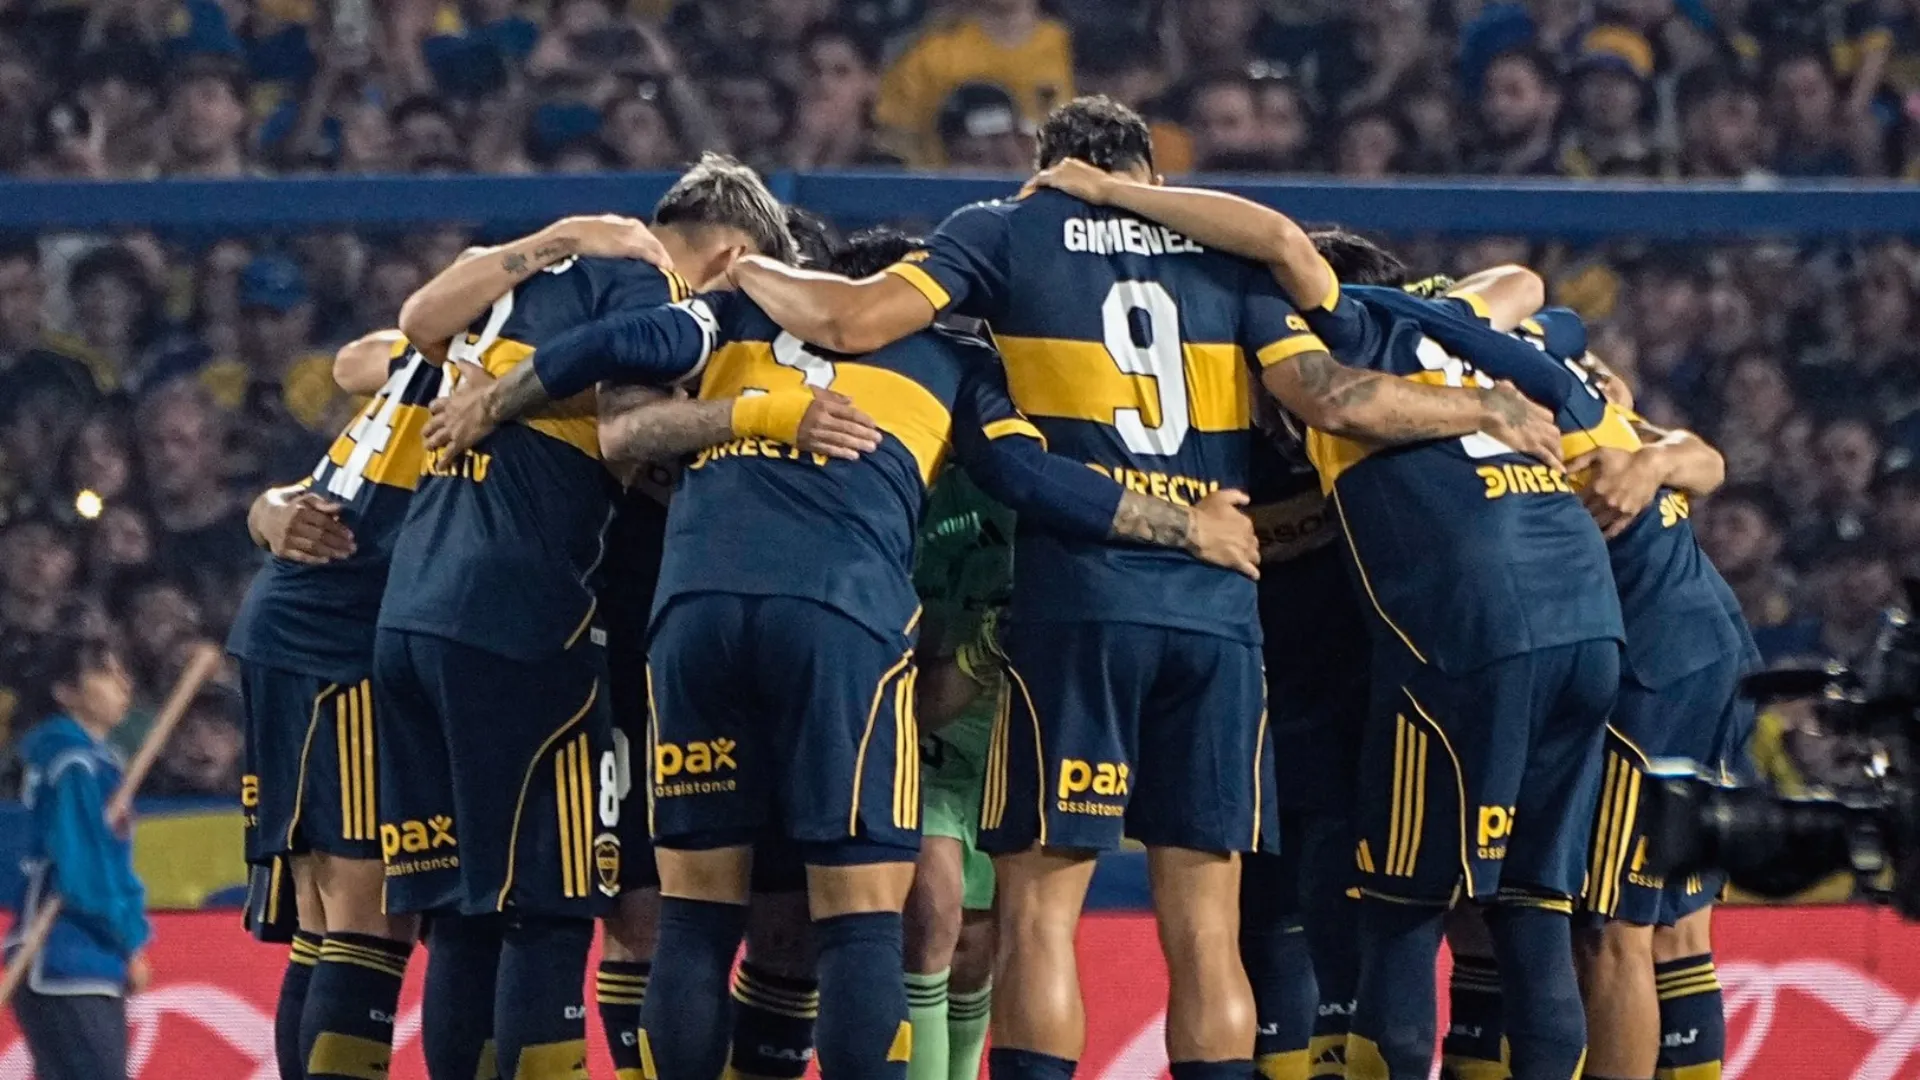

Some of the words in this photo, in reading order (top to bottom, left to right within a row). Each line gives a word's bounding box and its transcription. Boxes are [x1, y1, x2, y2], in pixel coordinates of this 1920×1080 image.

[1102, 279, 1190, 457] 9
[1476, 463, 1575, 499] DIREC
[655, 737, 737, 785] pax
[1058, 758, 1129, 799] pax
[655, 779, 737, 798] assistance
[380, 814, 457, 865] pax
